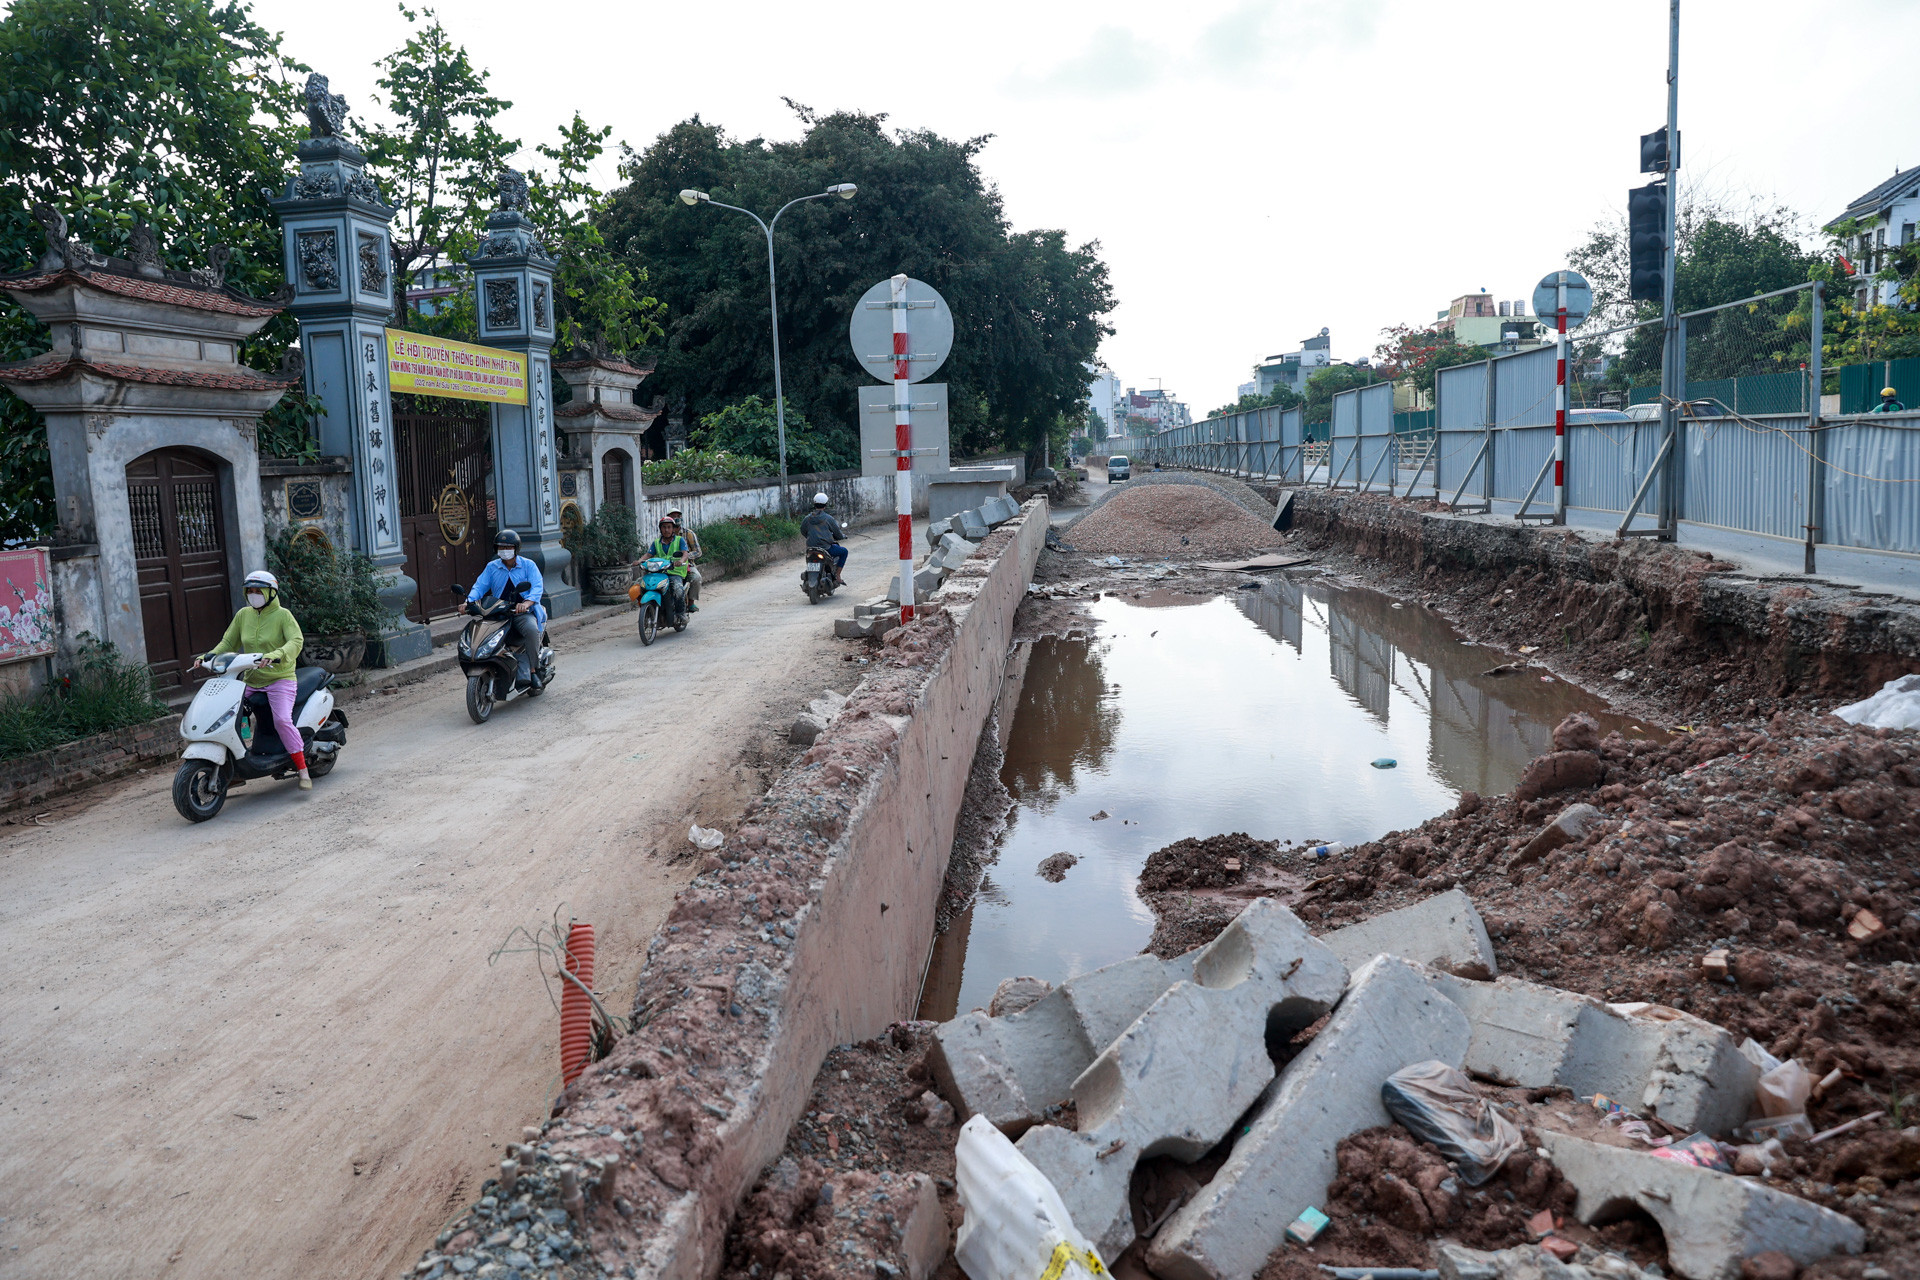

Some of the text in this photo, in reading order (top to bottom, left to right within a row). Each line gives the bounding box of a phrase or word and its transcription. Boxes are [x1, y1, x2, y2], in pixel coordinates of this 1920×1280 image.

[395, 336, 520, 373] LỄ HỘI TRUYỀN THỐNG ĐÌNH NHẬT TÂN
